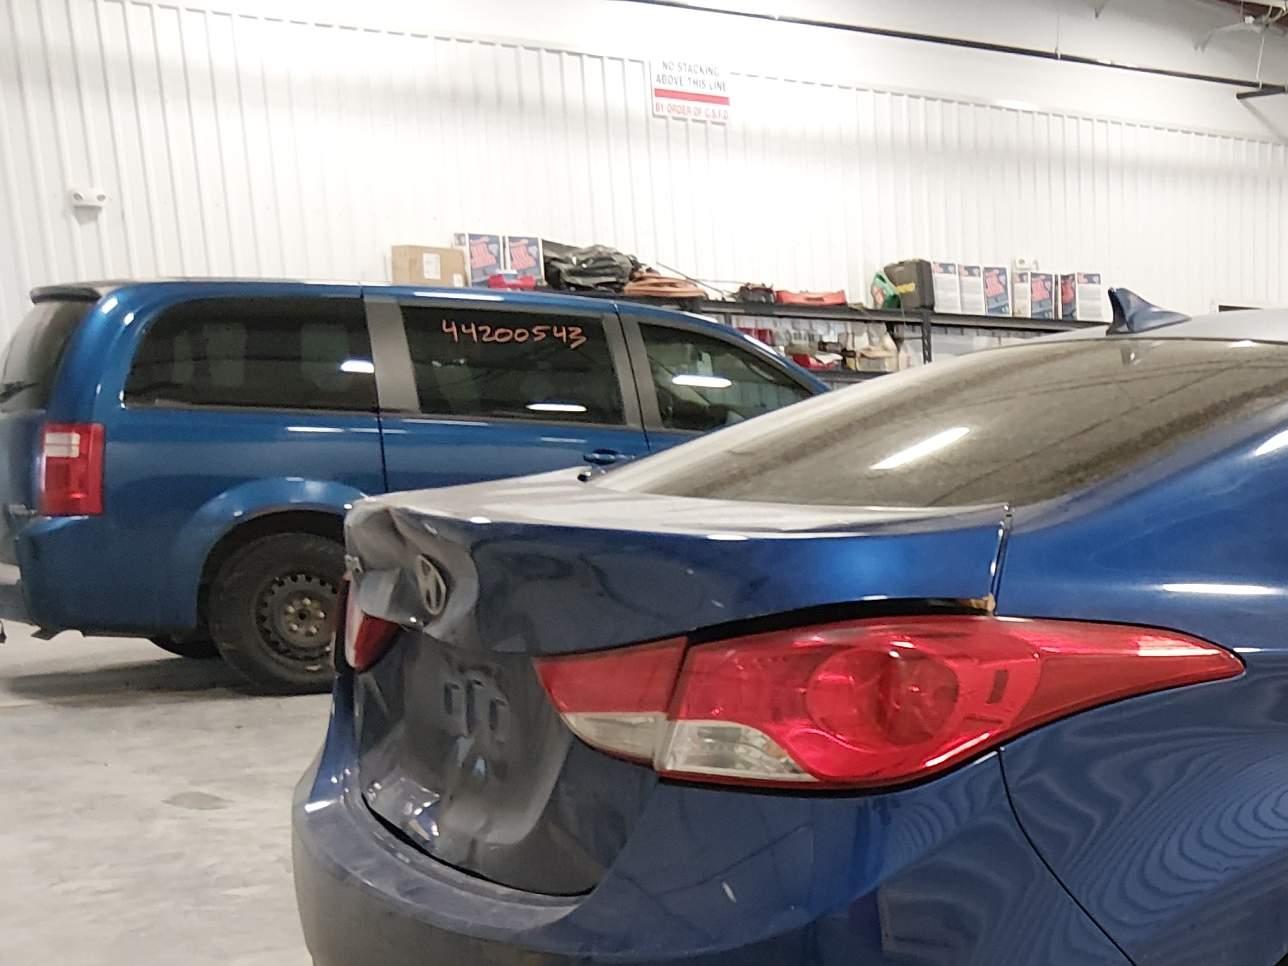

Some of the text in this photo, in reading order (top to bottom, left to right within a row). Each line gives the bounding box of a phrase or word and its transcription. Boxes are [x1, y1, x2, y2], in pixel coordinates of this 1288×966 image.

[662, 60, 720, 77] NO STACKING
[656, 73, 727, 92] ABOVE THIS LINE
[441, 319, 588, 350] 44200543
